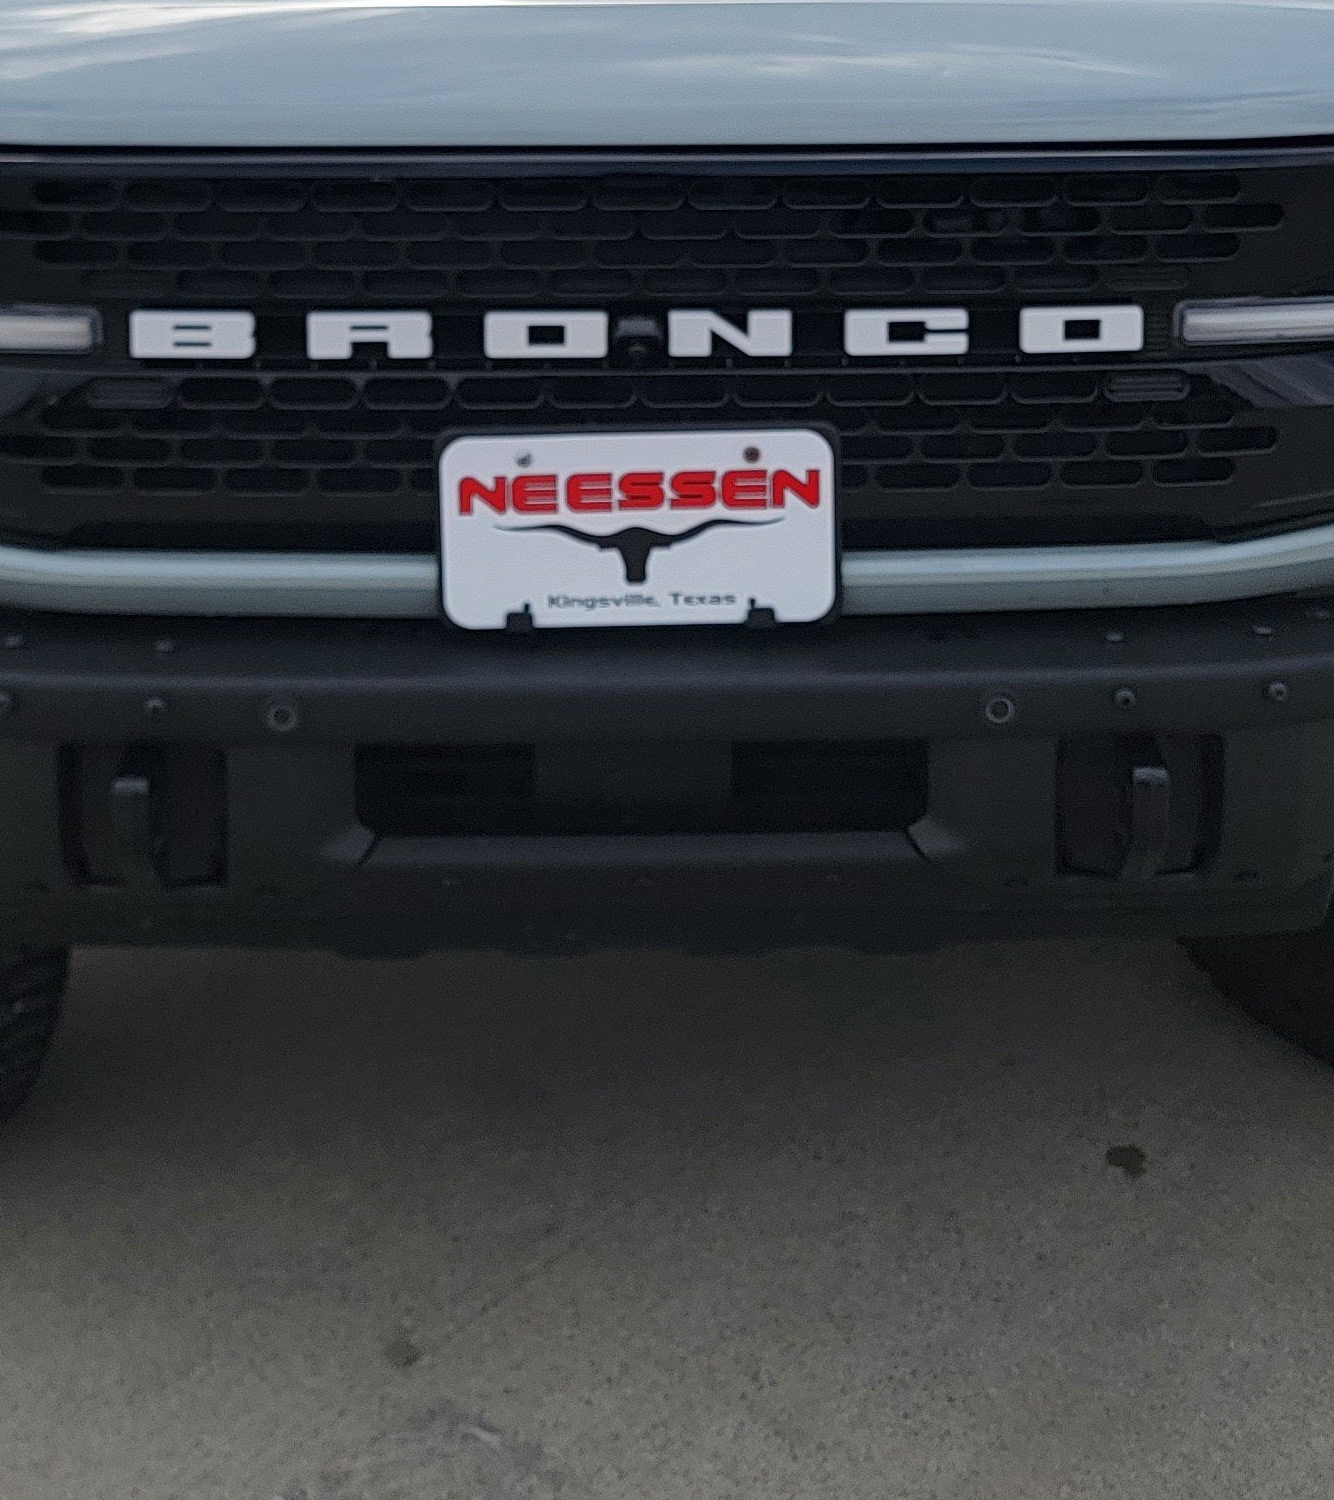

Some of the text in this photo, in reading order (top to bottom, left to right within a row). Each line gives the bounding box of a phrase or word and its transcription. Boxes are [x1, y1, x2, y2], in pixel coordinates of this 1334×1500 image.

[128, 304, 1145, 360] BRONCO
[458, 468, 820, 515] NEESSEN
[669, 592, 736, 607] Texas
